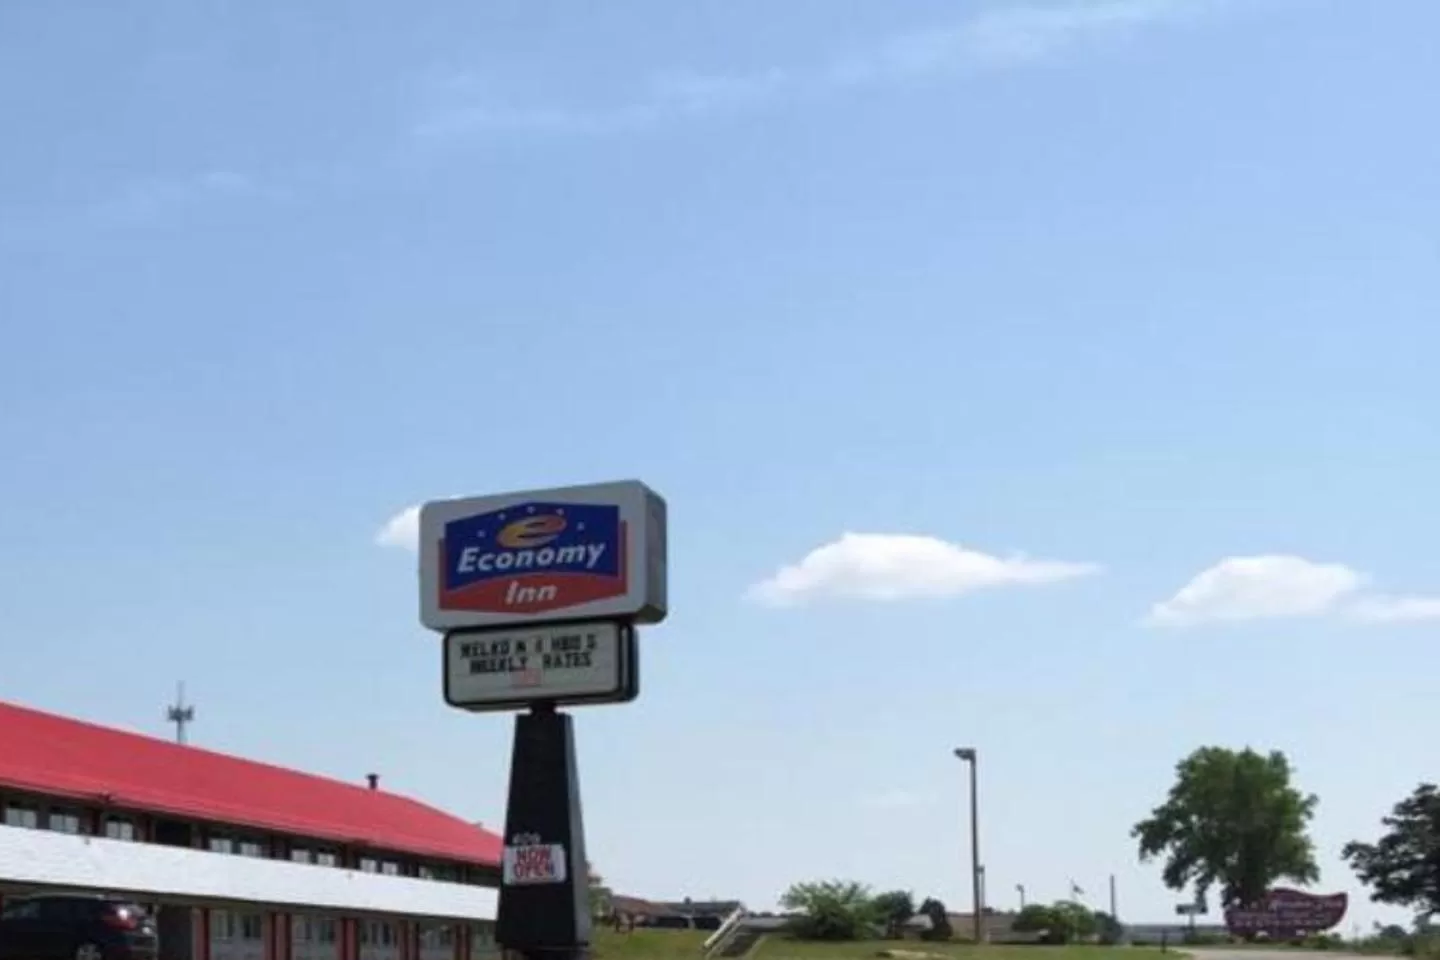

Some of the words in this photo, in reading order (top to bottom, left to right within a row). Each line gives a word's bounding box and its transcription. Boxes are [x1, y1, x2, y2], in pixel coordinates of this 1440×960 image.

[457, 542, 604, 573] Economy
[506, 581, 558, 605] Inn
[543, 651, 591, 670] RATES
[513, 862, 555, 878] OPEN
